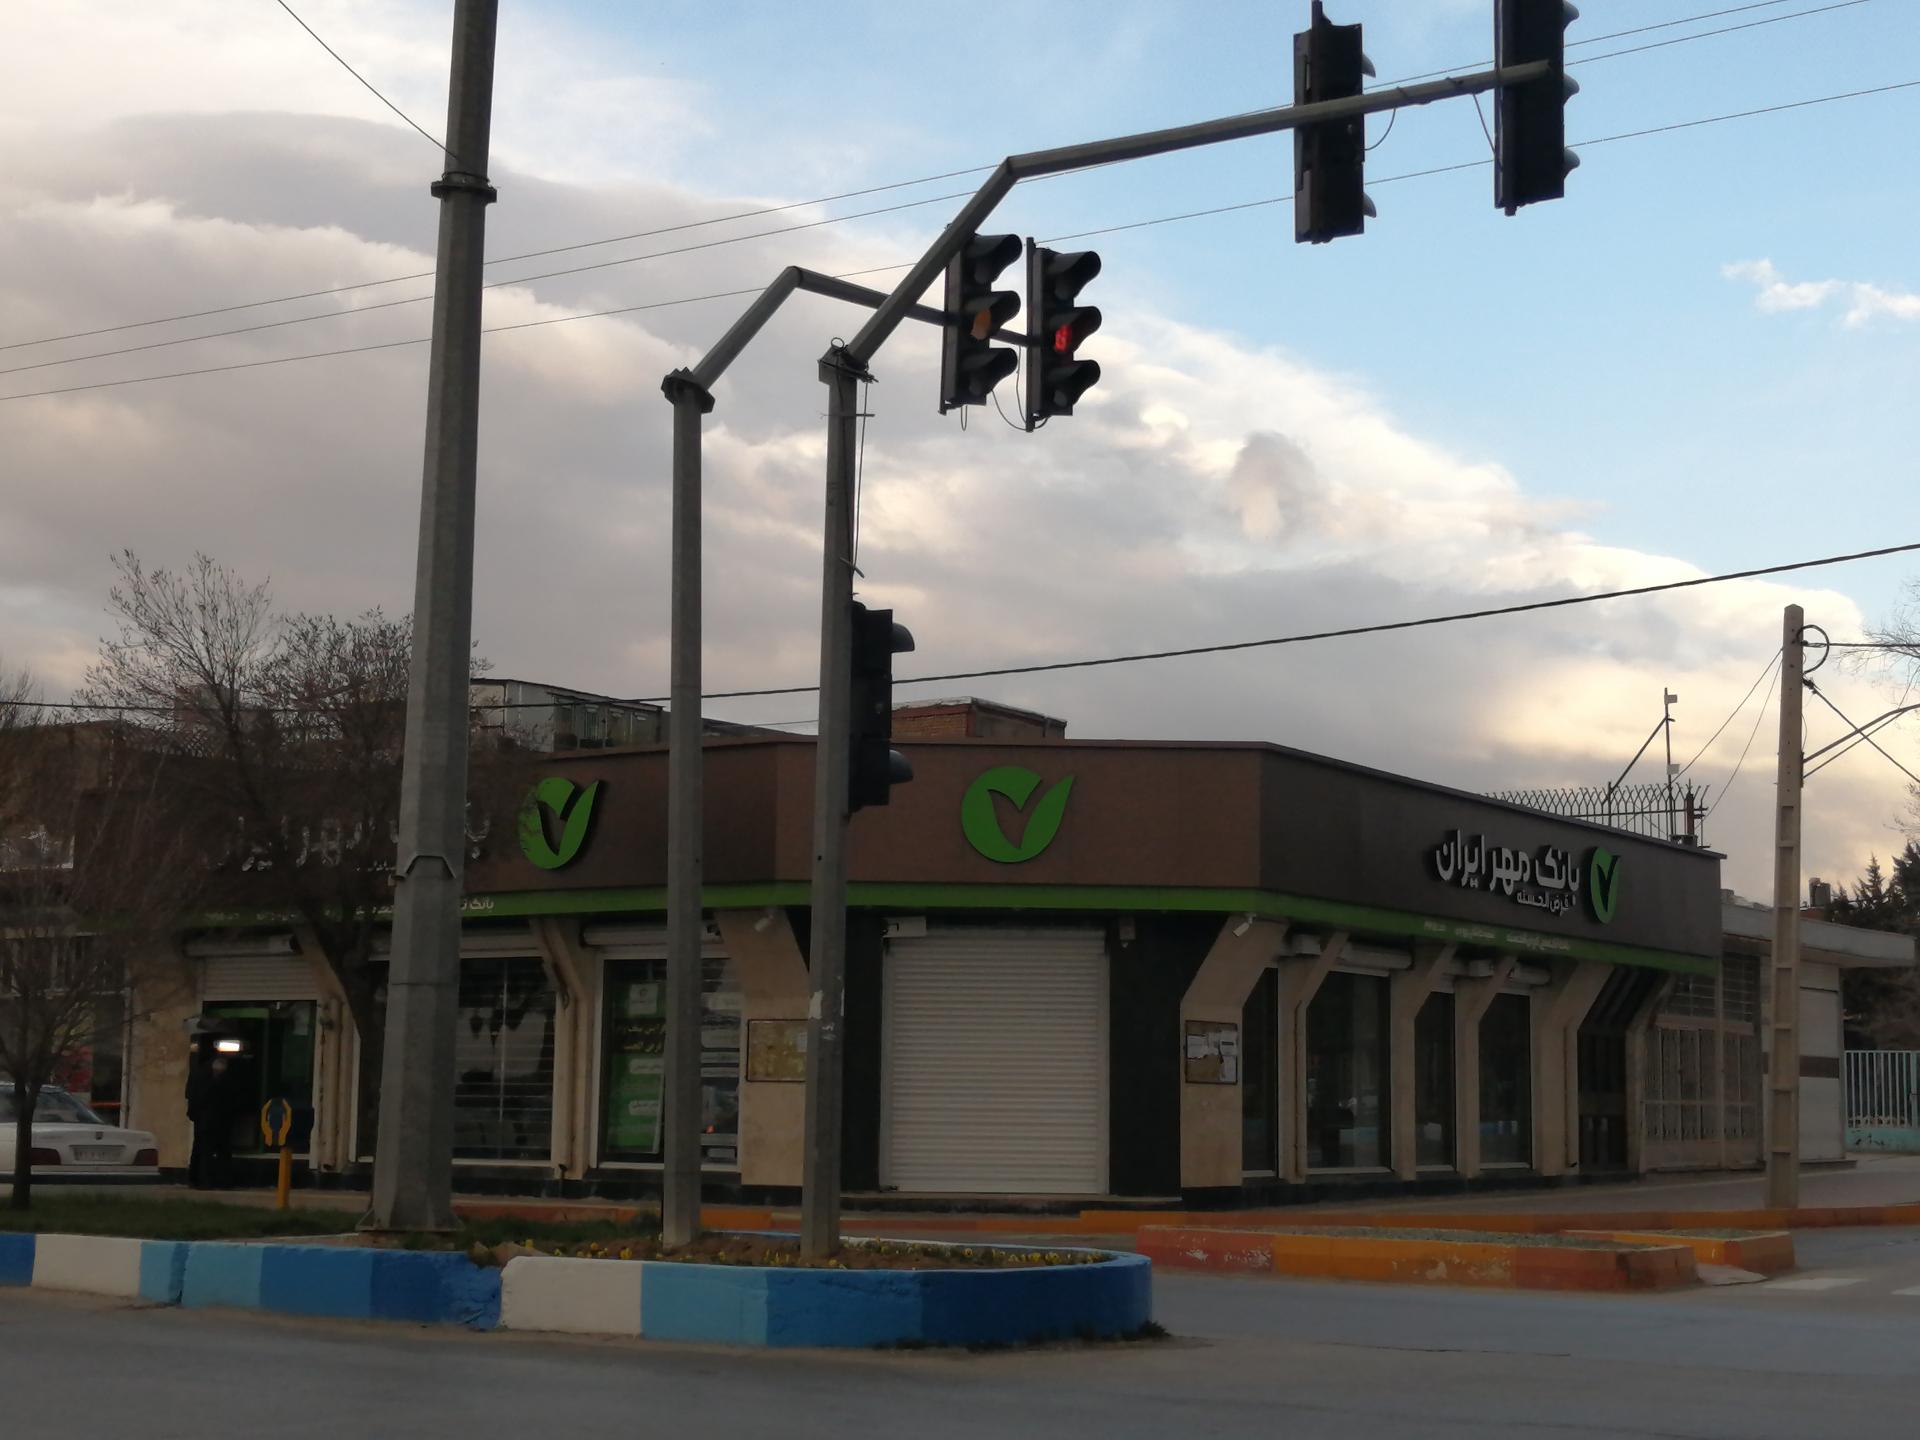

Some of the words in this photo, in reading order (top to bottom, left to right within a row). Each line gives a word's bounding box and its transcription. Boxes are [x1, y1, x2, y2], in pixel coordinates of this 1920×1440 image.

[1436, 829, 1486, 888] ایران
[1489, 848, 1531, 895] مهر
[1535, 847, 1580, 905] بانک
